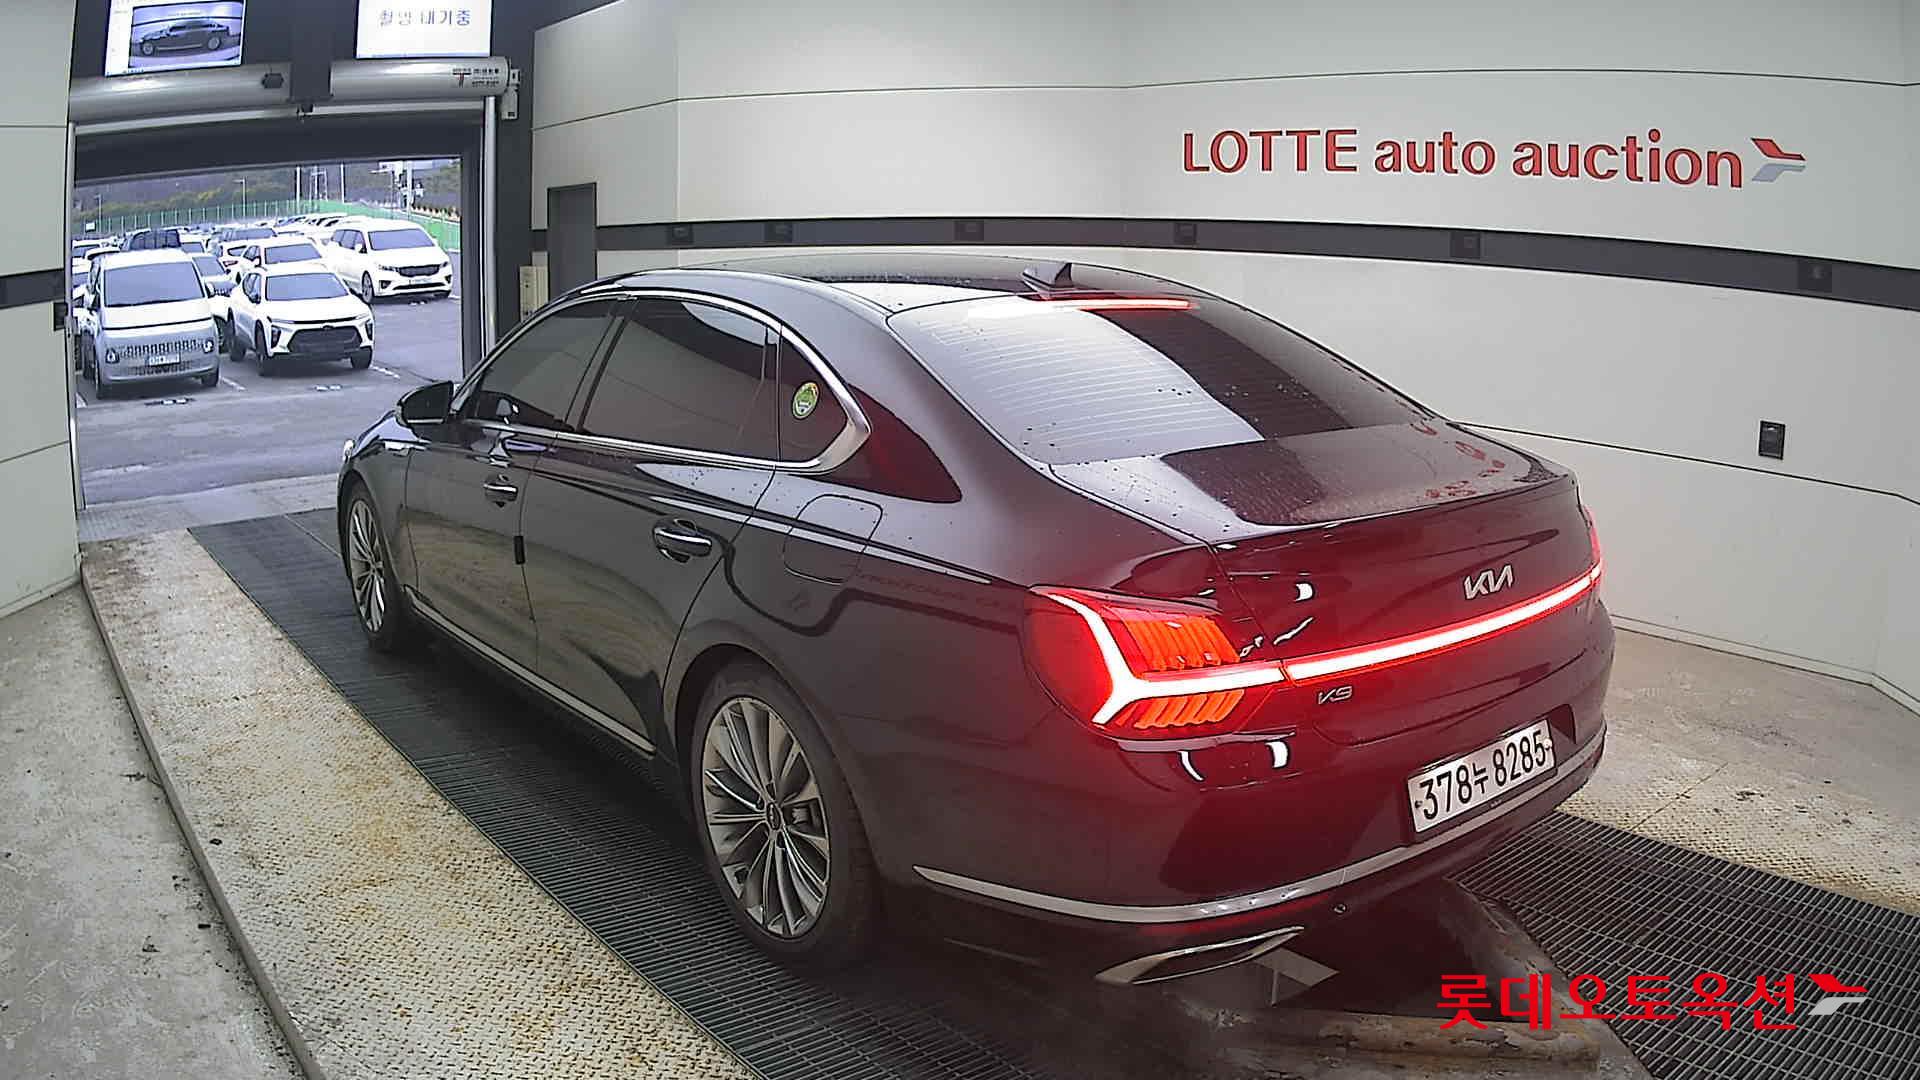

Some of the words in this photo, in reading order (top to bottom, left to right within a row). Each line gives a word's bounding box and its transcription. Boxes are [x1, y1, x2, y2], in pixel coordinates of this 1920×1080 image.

[1183, 129, 1358, 173] LOTTE
[1374, 131, 1496, 175] auto
[1512, 128, 1743, 188] auction
[1463, 564, 1514, 600] KIA
[1317, 685, 1353, 705] K9
[1492, 729, 1546, 787] 8285
